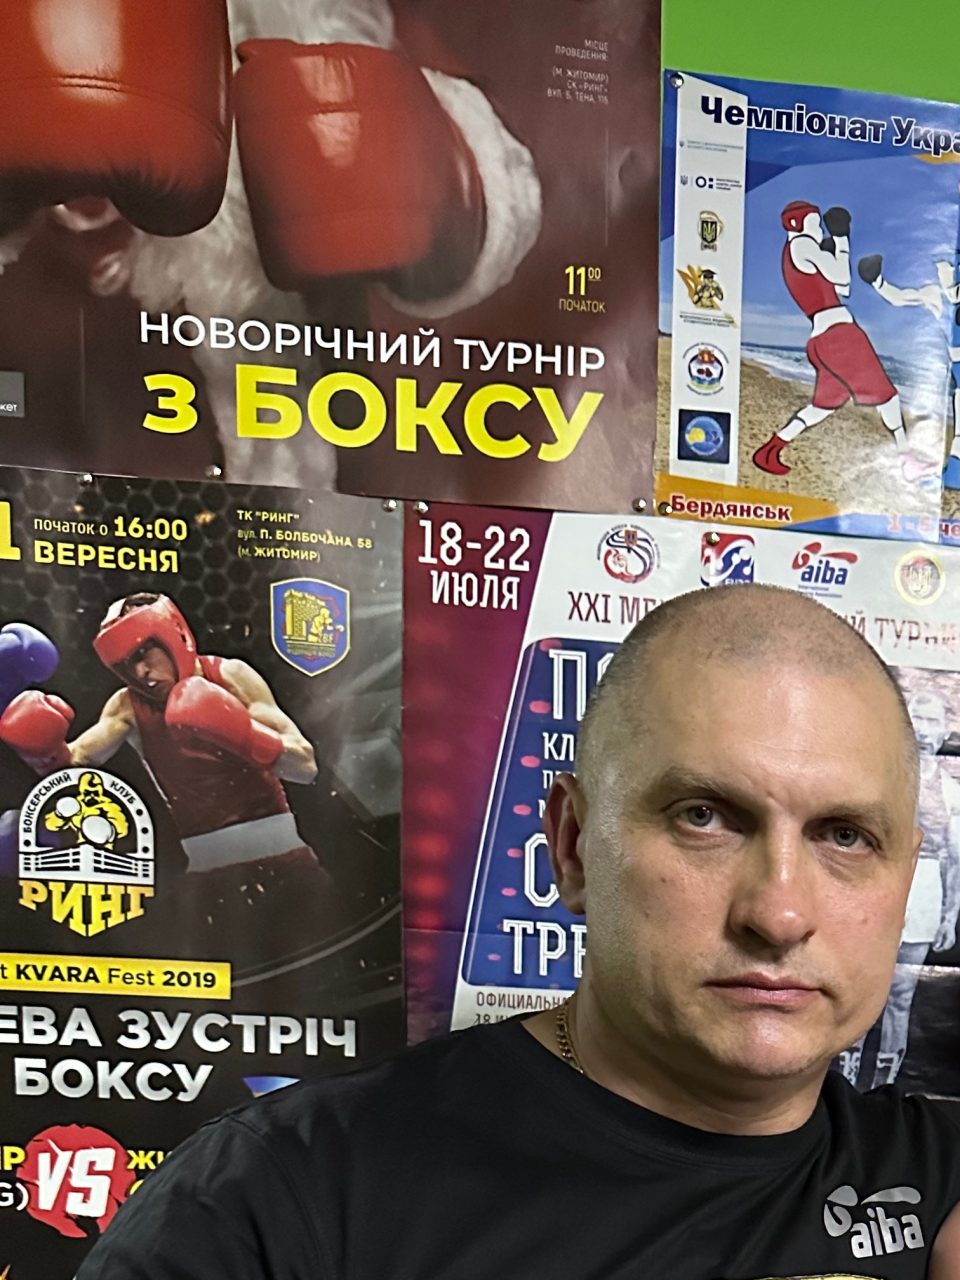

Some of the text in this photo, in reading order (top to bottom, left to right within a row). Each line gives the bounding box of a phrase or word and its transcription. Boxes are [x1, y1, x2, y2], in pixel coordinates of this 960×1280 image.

[700, 94, 887, 144] Чемпіонат
[558, 298, 607, 315] ПОЧАТОК
[139, 310, 606, 380] НОВОРІЧНИЙ ТУРНІР
[235, 363, 605, 463] БОКСУ
[34, 517, 95, 536] початок
[114, 516, 188, 541] 16:00
[237, 509, 253, 521] ТК
[669, 494, 791, 522] Бердянськ
[34, 540, 179, 573] ВЕРЕСНЯ
[254, 546, 320, 563] ЖИТОМИР)
[260, 529, 272, 540] П.
[275, 530, 353, 548] БОЛБОЧАНА
[357, 537, 373, 549] 58
[418, 519, 531, 573] 18-22
[430, 569, 521, 611] ИЮЛЯ
[800, 559, 848, 586] aiba
[567, 591, 612, 624] XXI
[23, 771, 136, 835] БОКСЕРСЬКИЙ КЛУБ
[18, 879, 155, 938] РИНГ
[16, 964, 100, 984] KVARA
[108, 968, 156, 986] Fest
[163, 970, 217, 989] 2019
[116, 1009, 357, 1059] ЗУСТРІЧ
[14, 1057, 214, 1103] БОКСУ
[37, 1139, 116, 1218] VS
[849, 1206, 925, 1259] aiba
